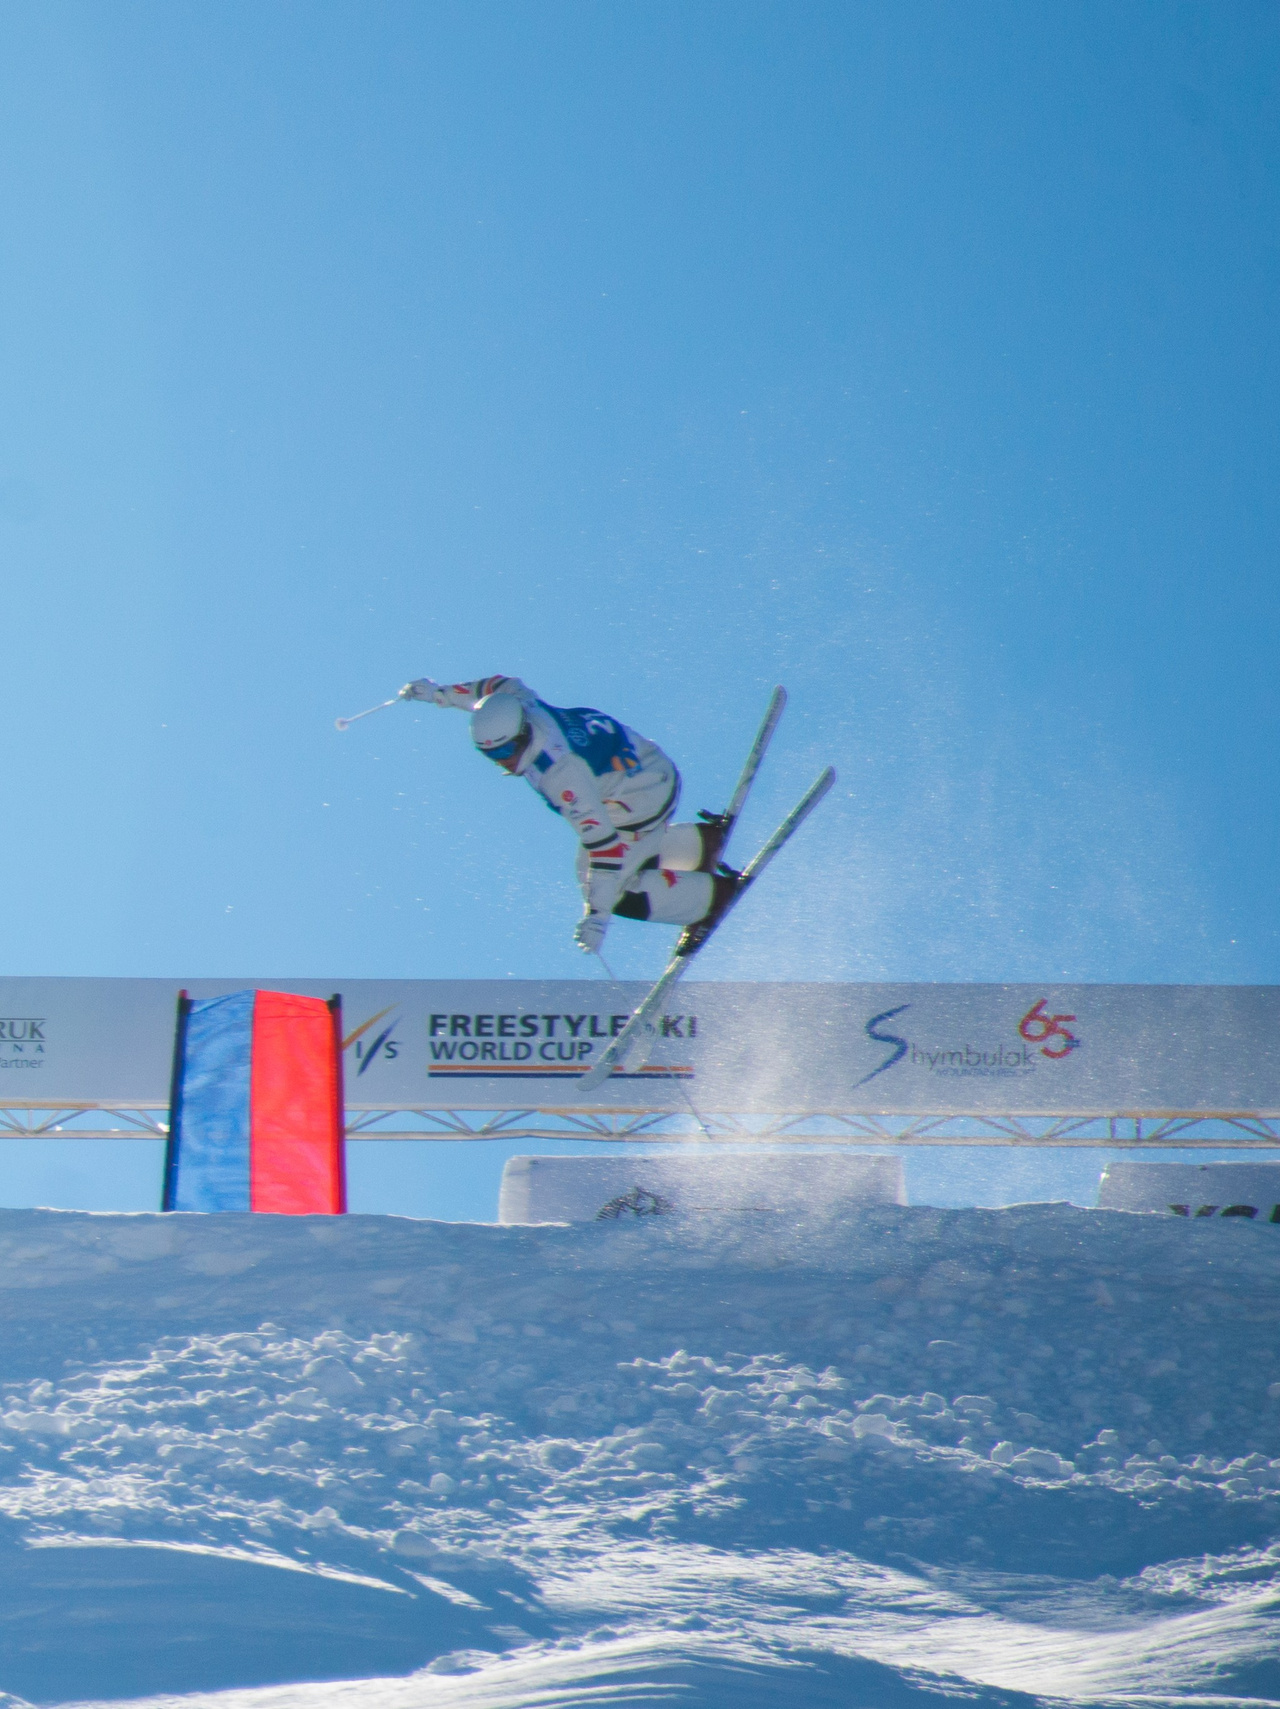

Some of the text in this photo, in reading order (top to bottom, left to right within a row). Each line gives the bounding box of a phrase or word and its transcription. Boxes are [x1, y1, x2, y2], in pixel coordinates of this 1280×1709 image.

[429, 1014, 629, 1038] FREESTYLE
[431, 1041, 593, 1061] WORLD CUP
